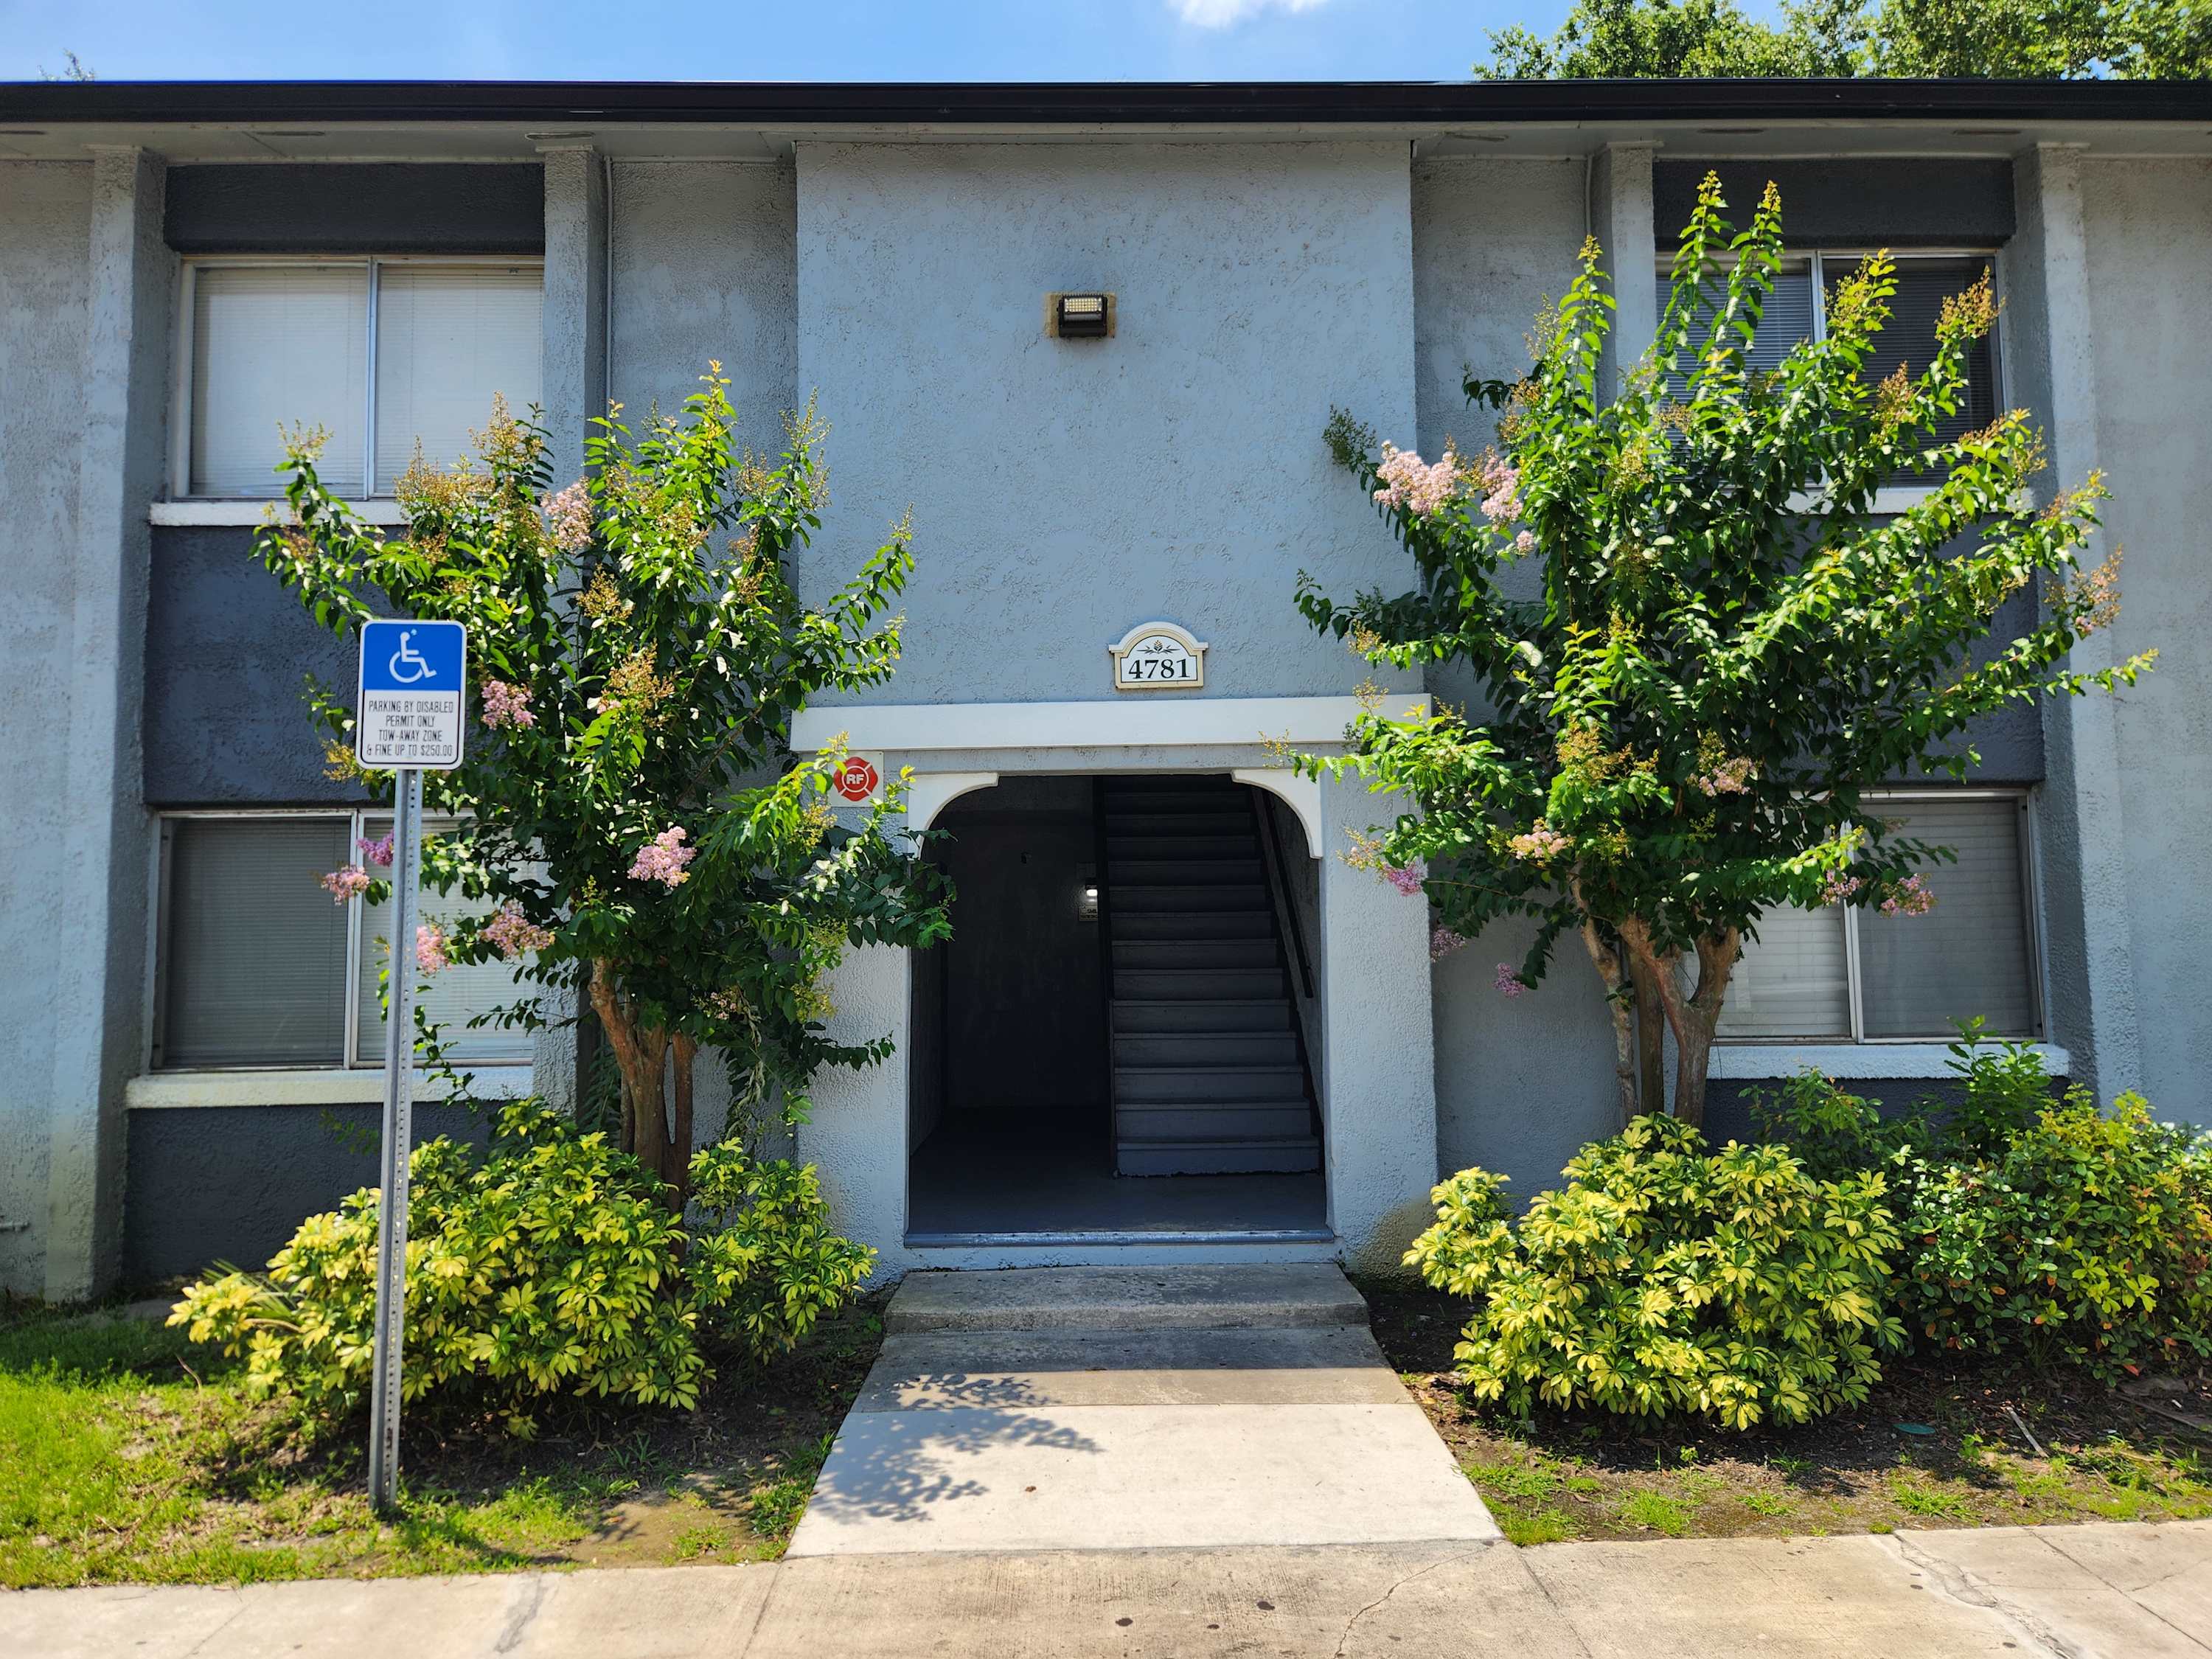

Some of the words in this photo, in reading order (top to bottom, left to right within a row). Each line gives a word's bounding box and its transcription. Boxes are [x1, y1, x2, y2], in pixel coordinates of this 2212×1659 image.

[1128, 658, 1191, 679] 4781
[369, 700, 400, 713] PARKING
[404, 701, 414, 713] BY
[417, 701, 453, 713] DISABLED
[386, 715, 414, 727] PERMIT
[417, 716, 435, 727] ONLY
[379, 729, 419, 742] TOW-AWAY
[422, 731, 442, 742] ZONE
[367, 744, 372, 756] &
[375, 744, 392, 756] FINE
[394, 745, 405, 756] UP
[408, 745, 417, 756] TO
[420, 745, 452, 757] $250.00
[846, 773, 865, 785] RF
